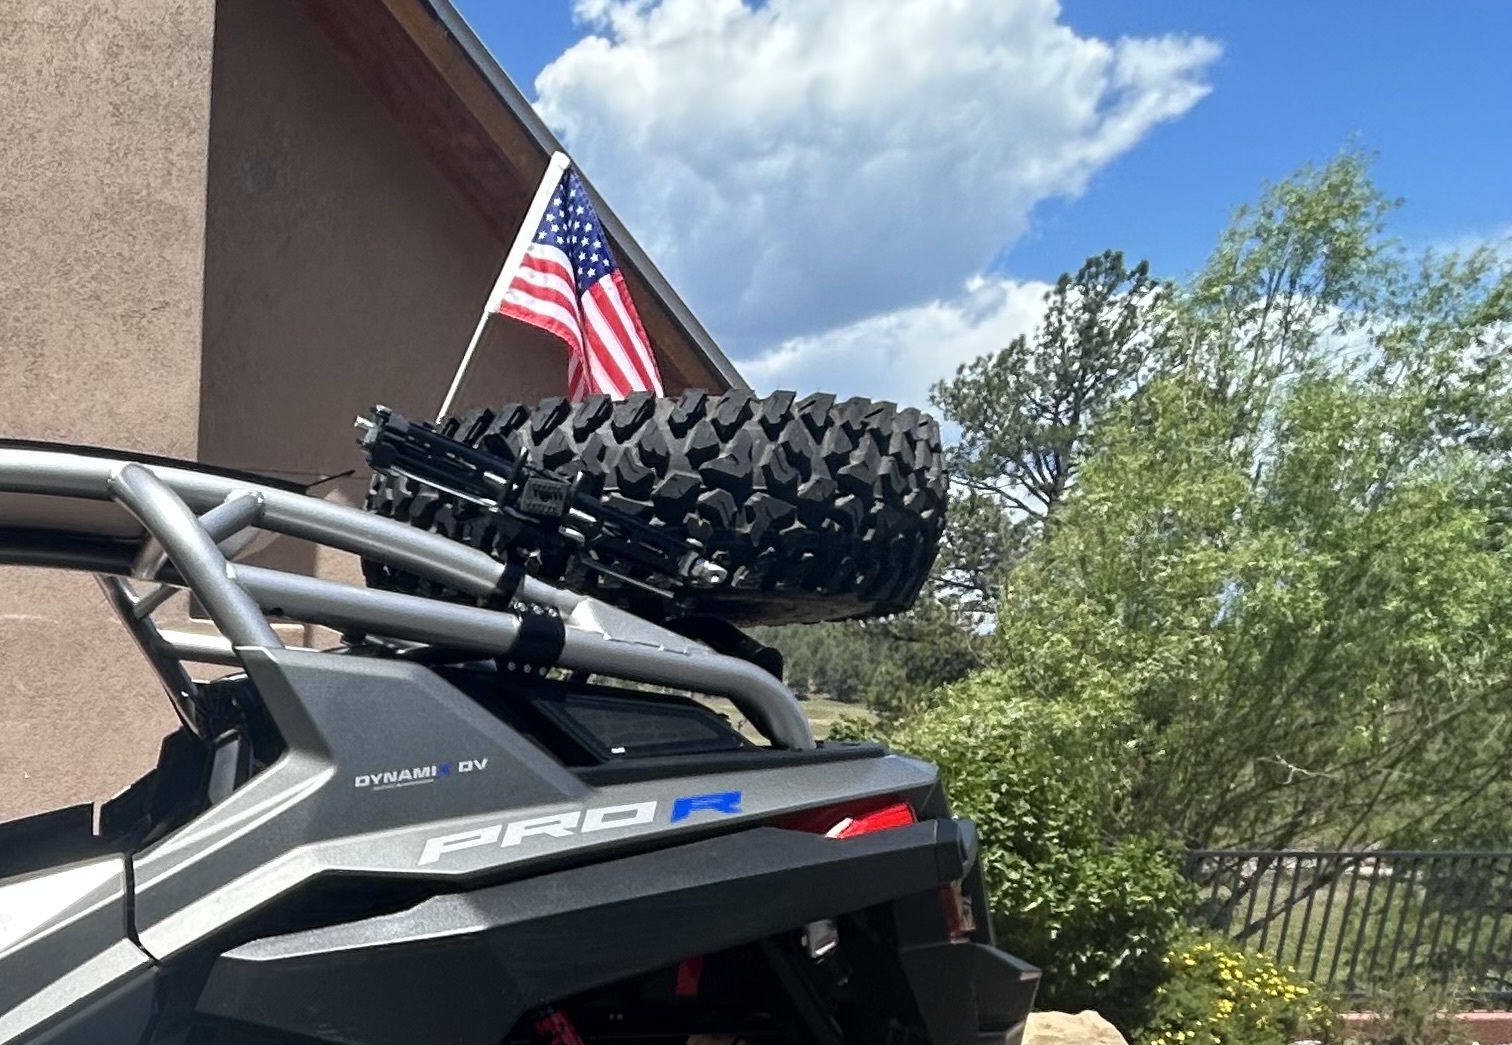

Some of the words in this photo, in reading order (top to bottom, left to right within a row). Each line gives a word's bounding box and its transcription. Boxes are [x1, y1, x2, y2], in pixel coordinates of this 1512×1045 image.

[458, 758, 489, 773] DV
[417, 800, 658, 867] PRO
[670, 790, 743, 824] R
